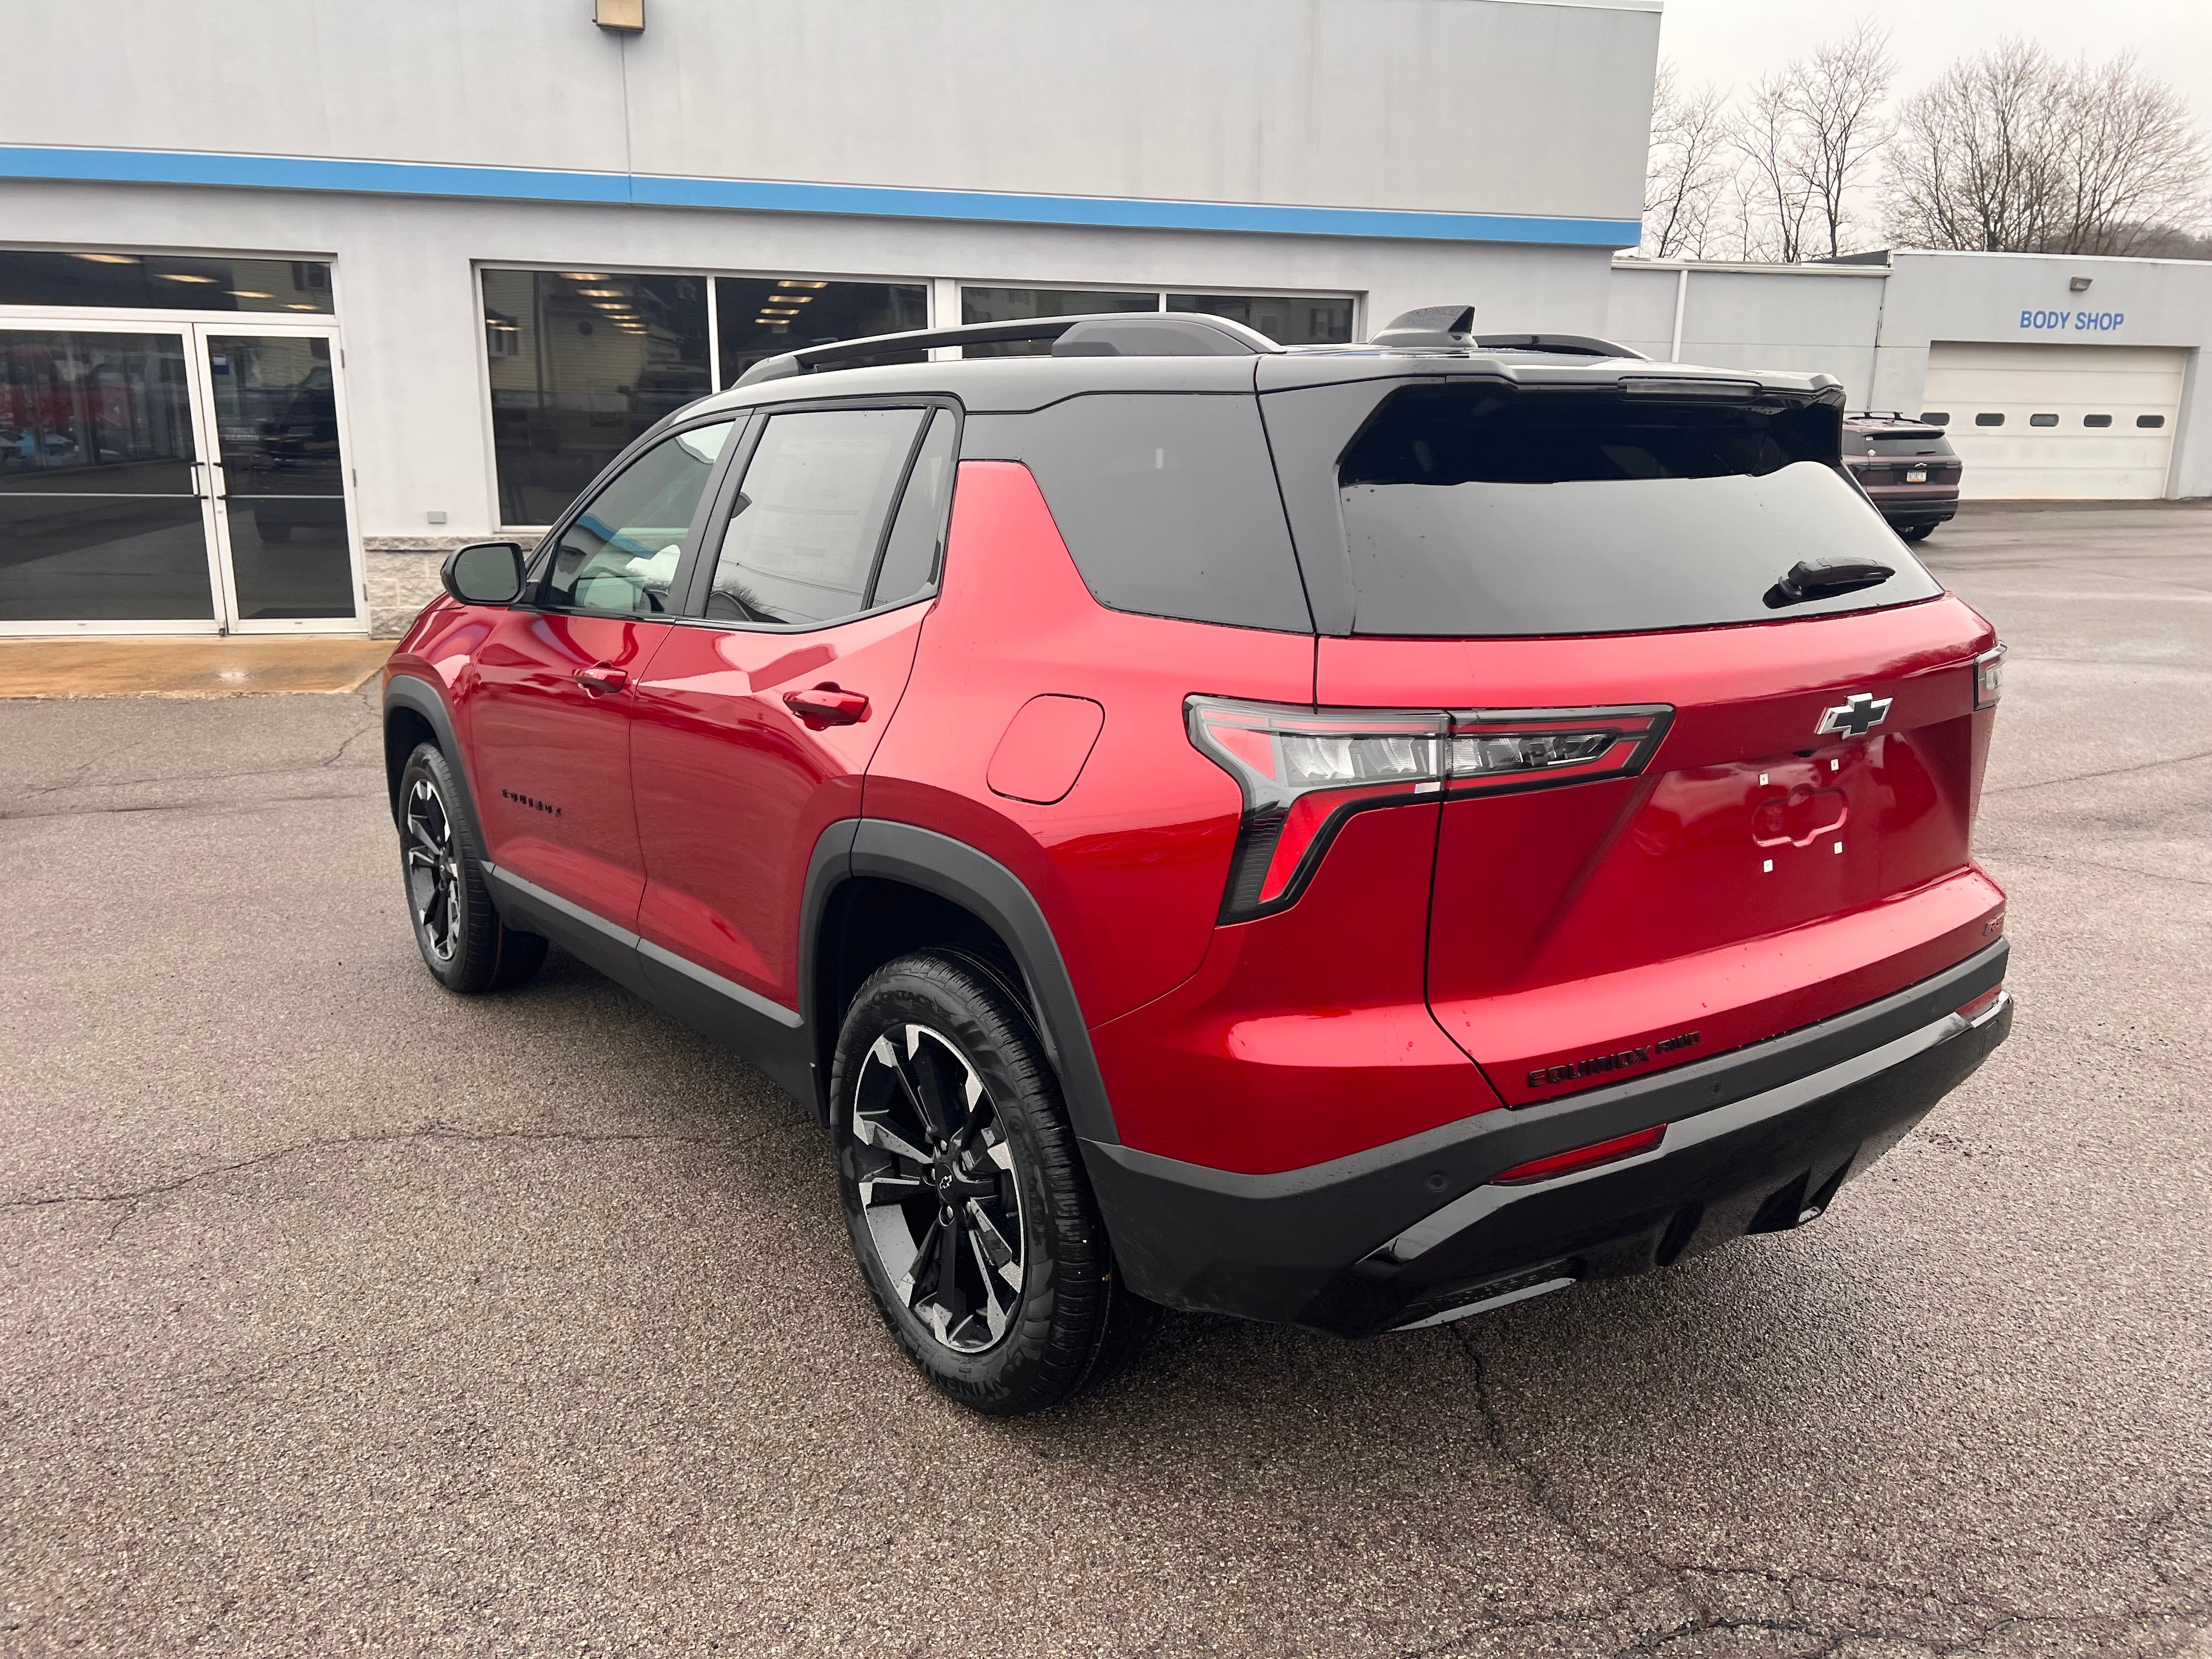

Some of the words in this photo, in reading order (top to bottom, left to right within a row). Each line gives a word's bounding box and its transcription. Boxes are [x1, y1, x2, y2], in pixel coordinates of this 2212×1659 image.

[2020, 311, 2071, 329] BODY
[2074, 312, 2125, 330] SHOP
[1527, 1045, 1652, 1088] EQUINOX
